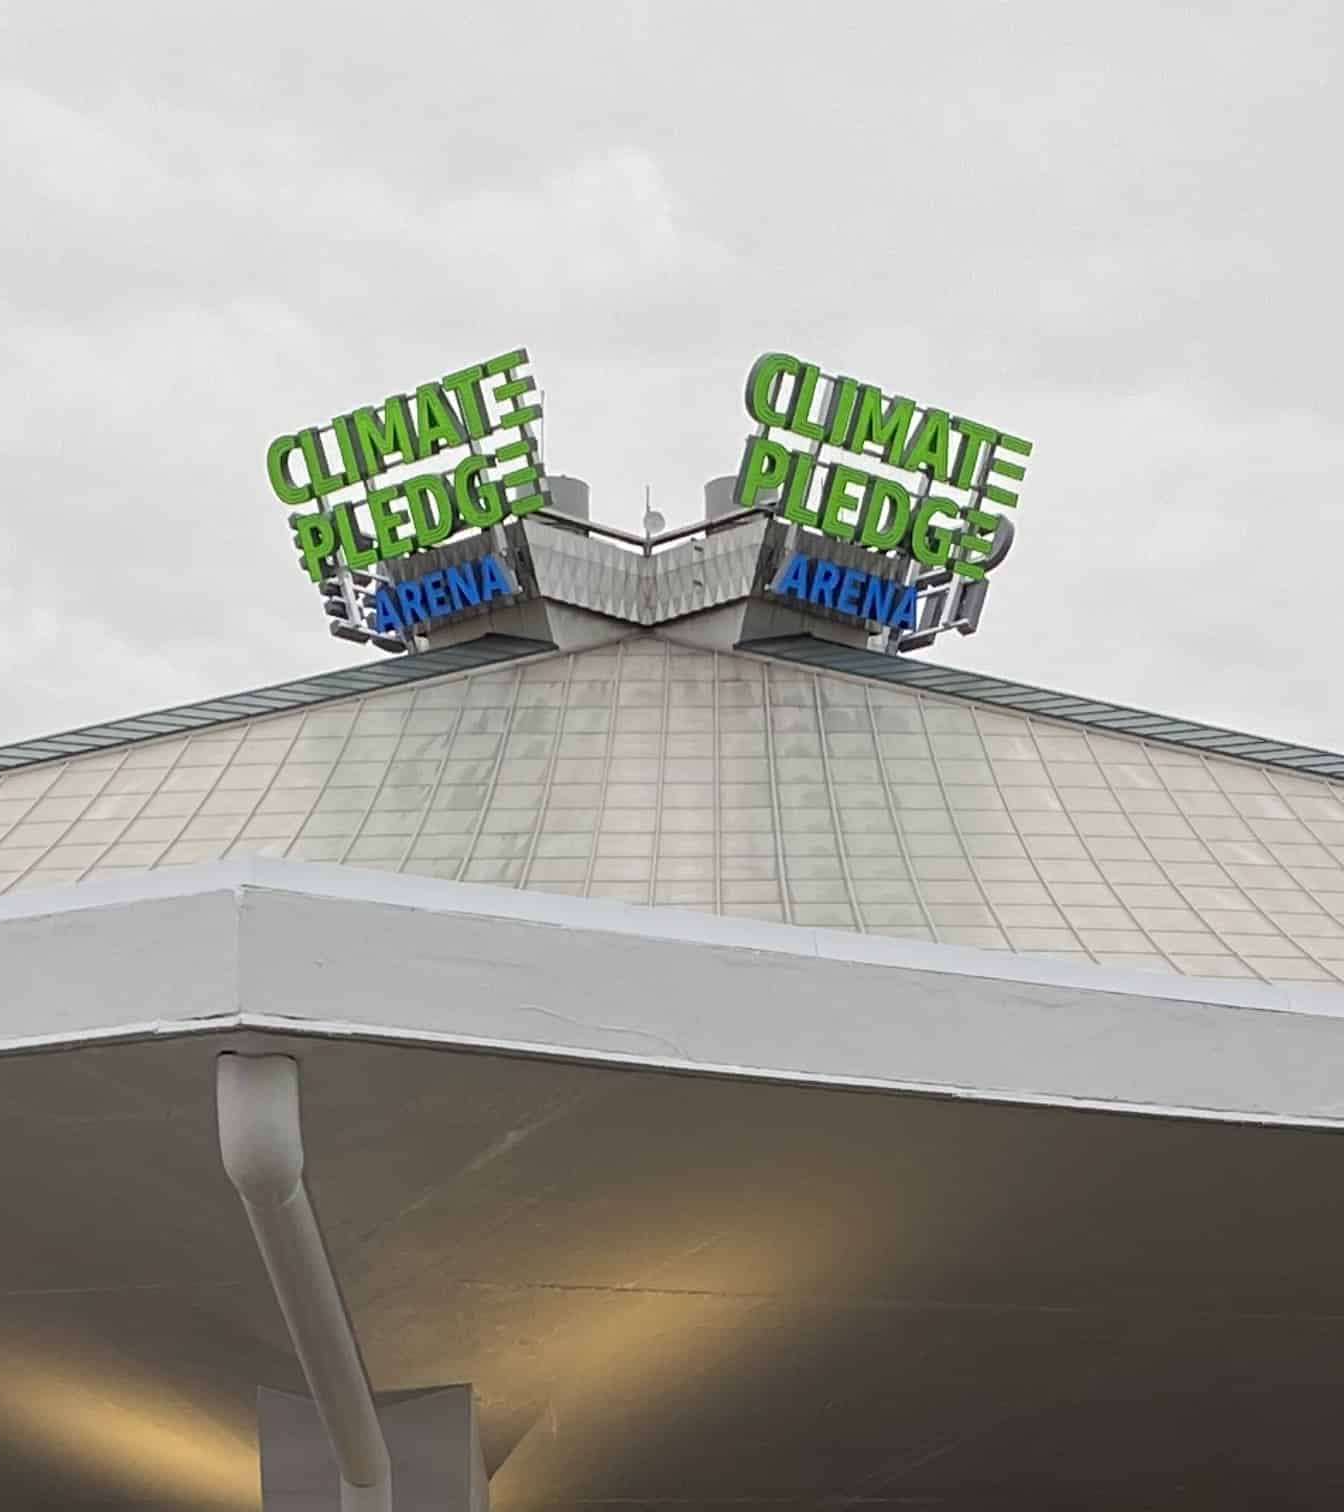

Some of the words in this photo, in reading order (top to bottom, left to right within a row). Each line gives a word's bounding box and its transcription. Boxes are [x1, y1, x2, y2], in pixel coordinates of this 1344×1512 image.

[267, 349, 542, 505] CLIMATE
[745, 352, 1033, 508] CLIMATE
[296, 439, 547, 583] PLEDGE
[734, 436, 1001, 580] PLEDGE
[376, 553, 512, 633] ARENA
[777, 552, 918, 632] ARENA
